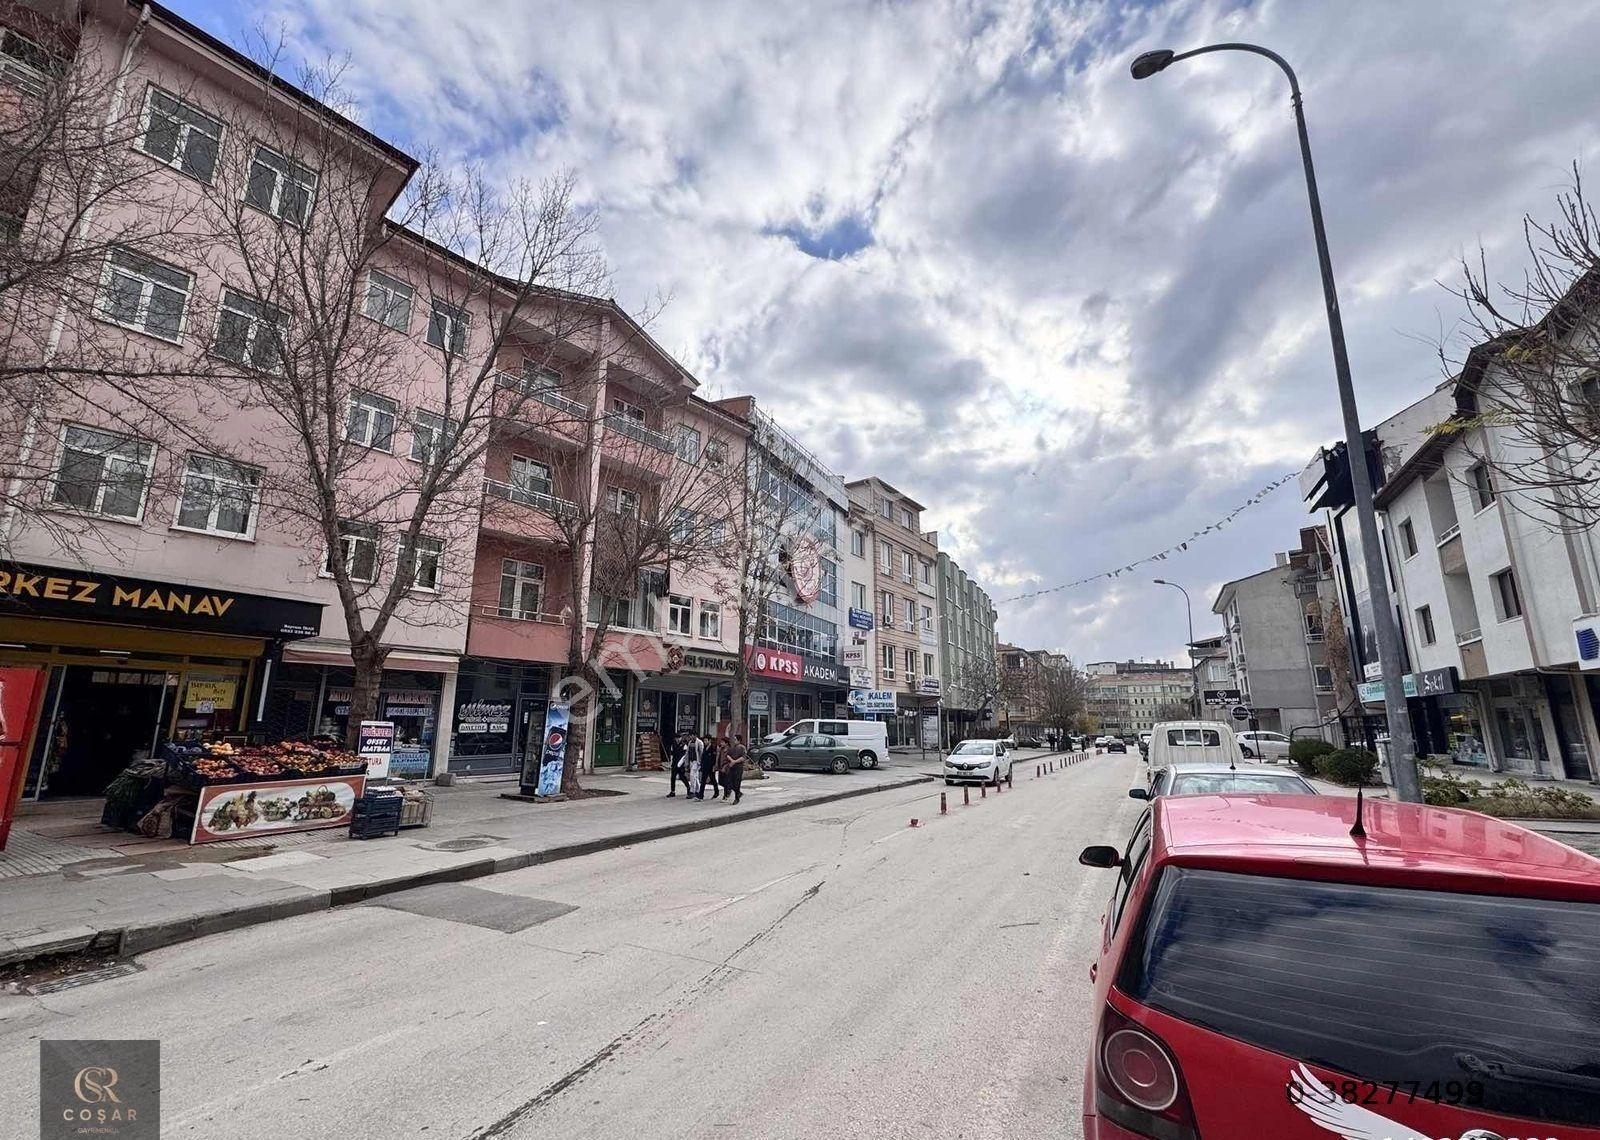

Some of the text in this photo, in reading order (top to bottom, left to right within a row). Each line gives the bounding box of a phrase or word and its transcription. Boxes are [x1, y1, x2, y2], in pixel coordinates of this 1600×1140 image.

[112, 586, 235, 617] MANAV
[769, 656, 799, 675] KPSS
[868, 691, 892, 700] KALEM
